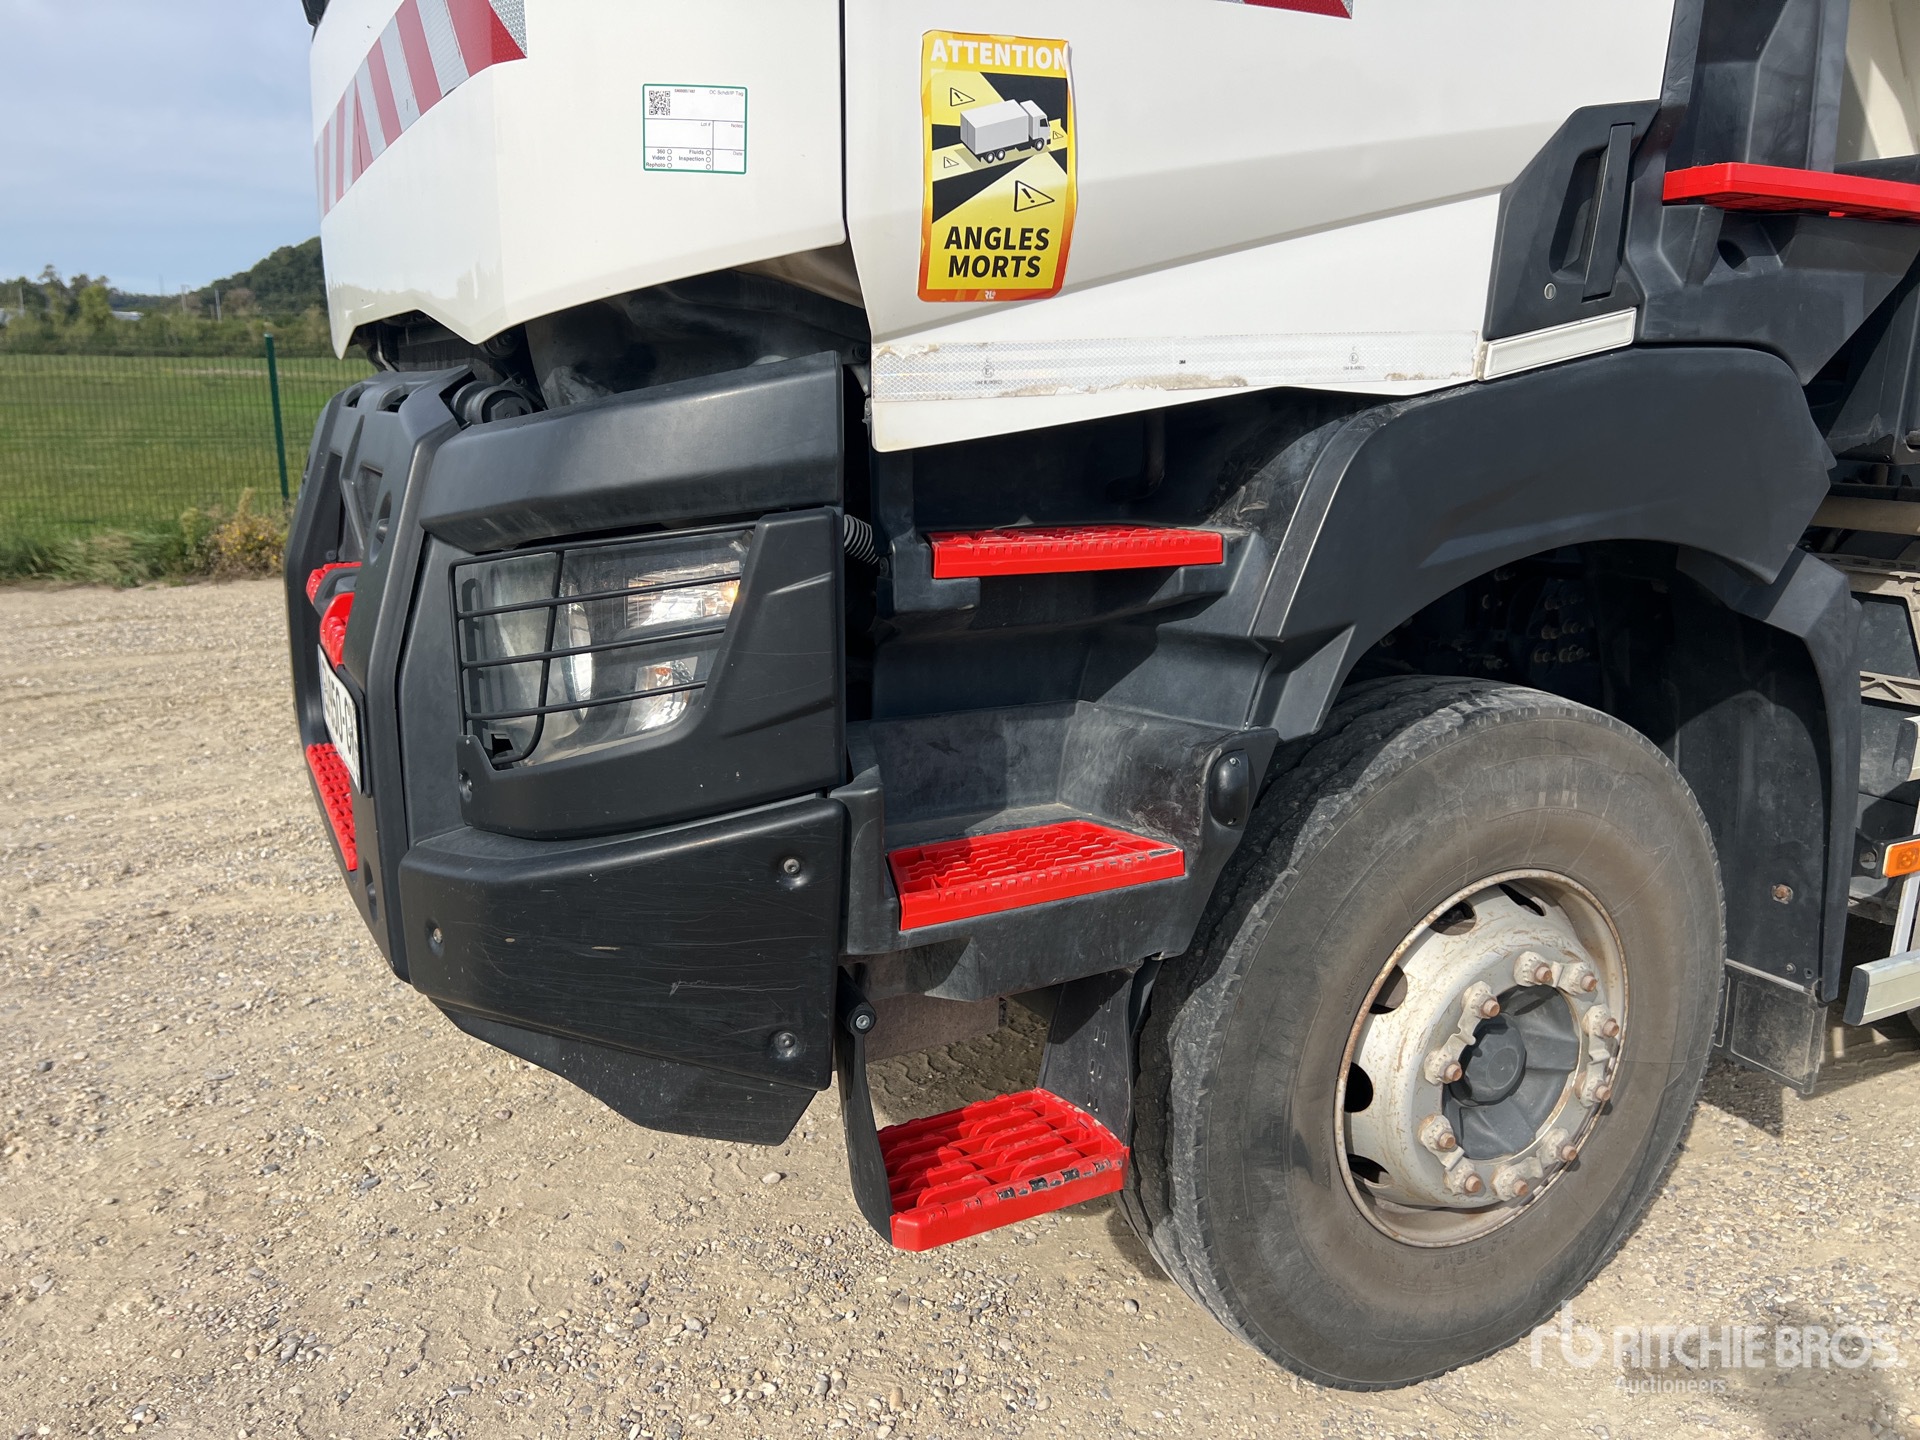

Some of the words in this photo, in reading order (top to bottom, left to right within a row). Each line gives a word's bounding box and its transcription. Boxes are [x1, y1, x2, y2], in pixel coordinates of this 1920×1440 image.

[930, 38, 1066, 71] ATTENTION
[943, 226, 1051, 251] ANGLES
[948, 255, 1042, 278] MORTS
